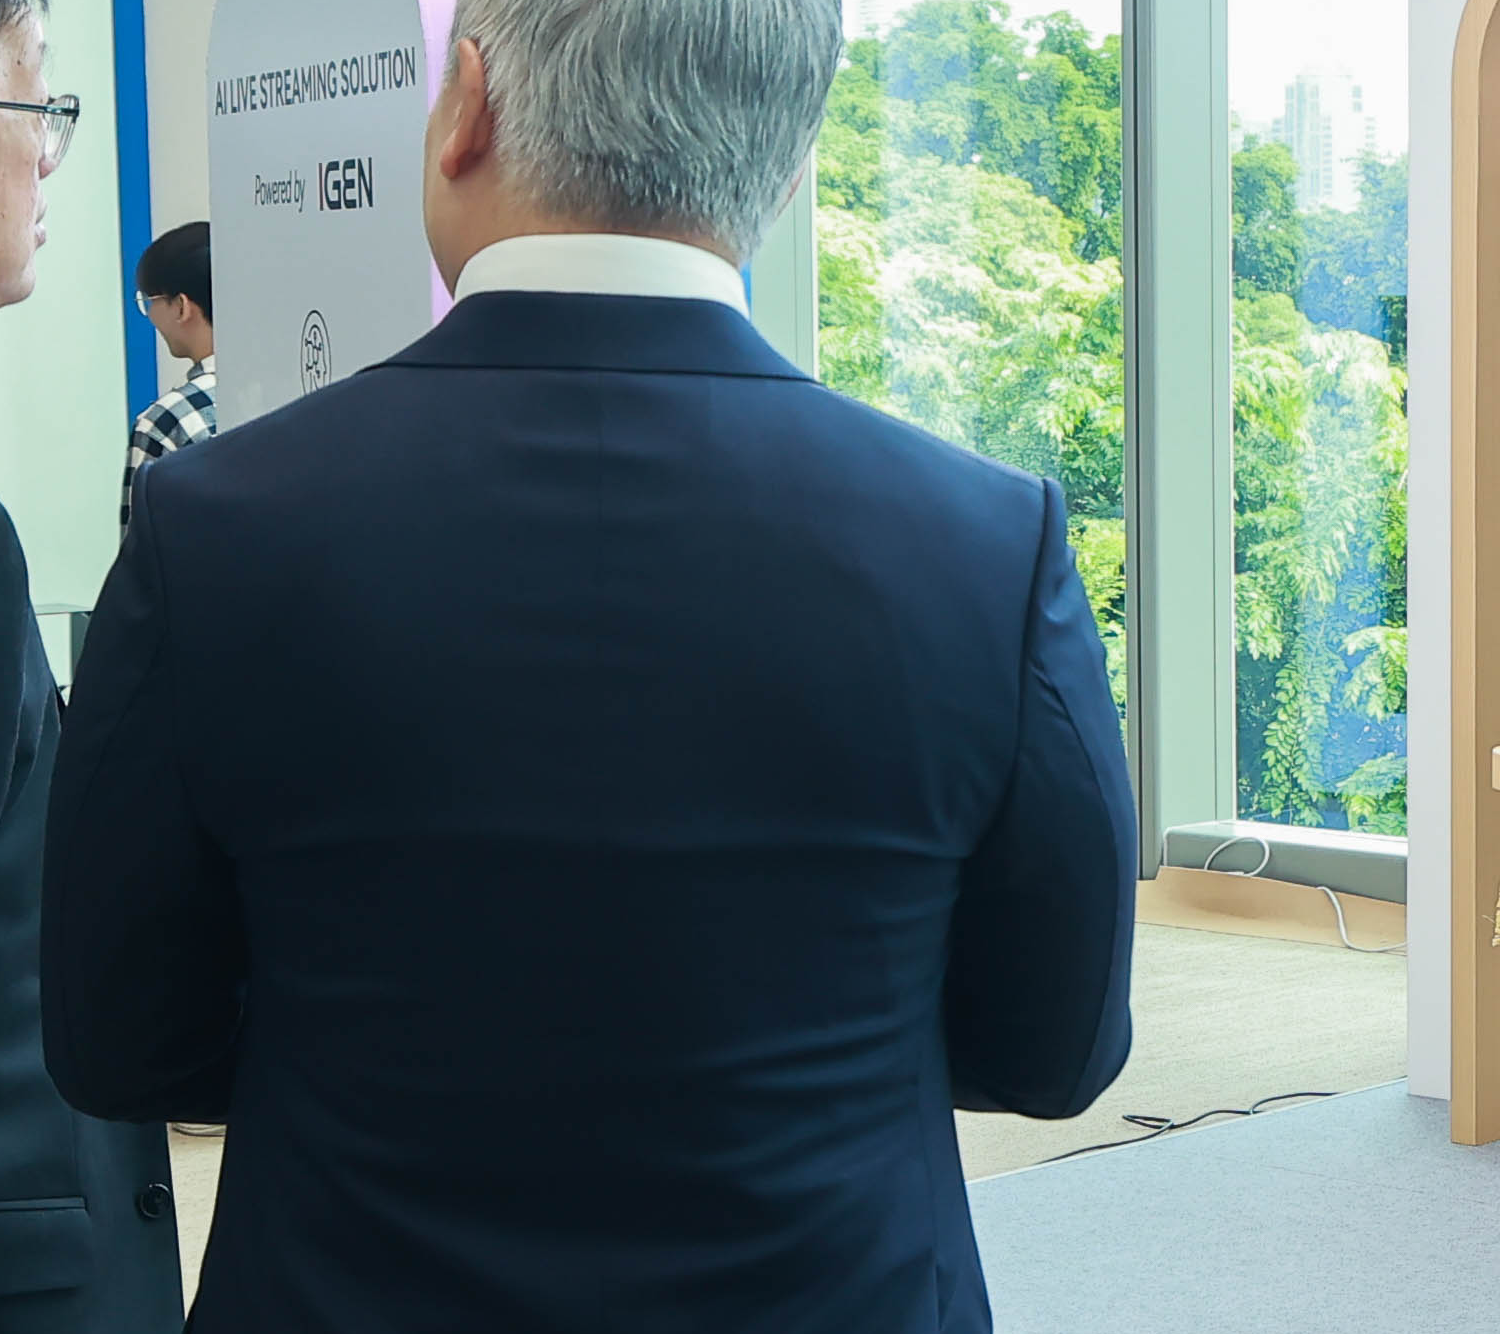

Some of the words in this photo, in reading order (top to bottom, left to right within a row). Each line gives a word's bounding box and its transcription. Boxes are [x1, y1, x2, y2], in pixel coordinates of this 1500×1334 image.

[215, 80, 228, 116] AI
[230, 75, 258, 114] LIVE
[260, 60, 338, 110] STREAMING
[341, 46, 416, 97] SOLUTION
[255, 170, 292, 206] Powered
[294, 170, 306, 213] by
[318, 157, 374, 212] IGEN
